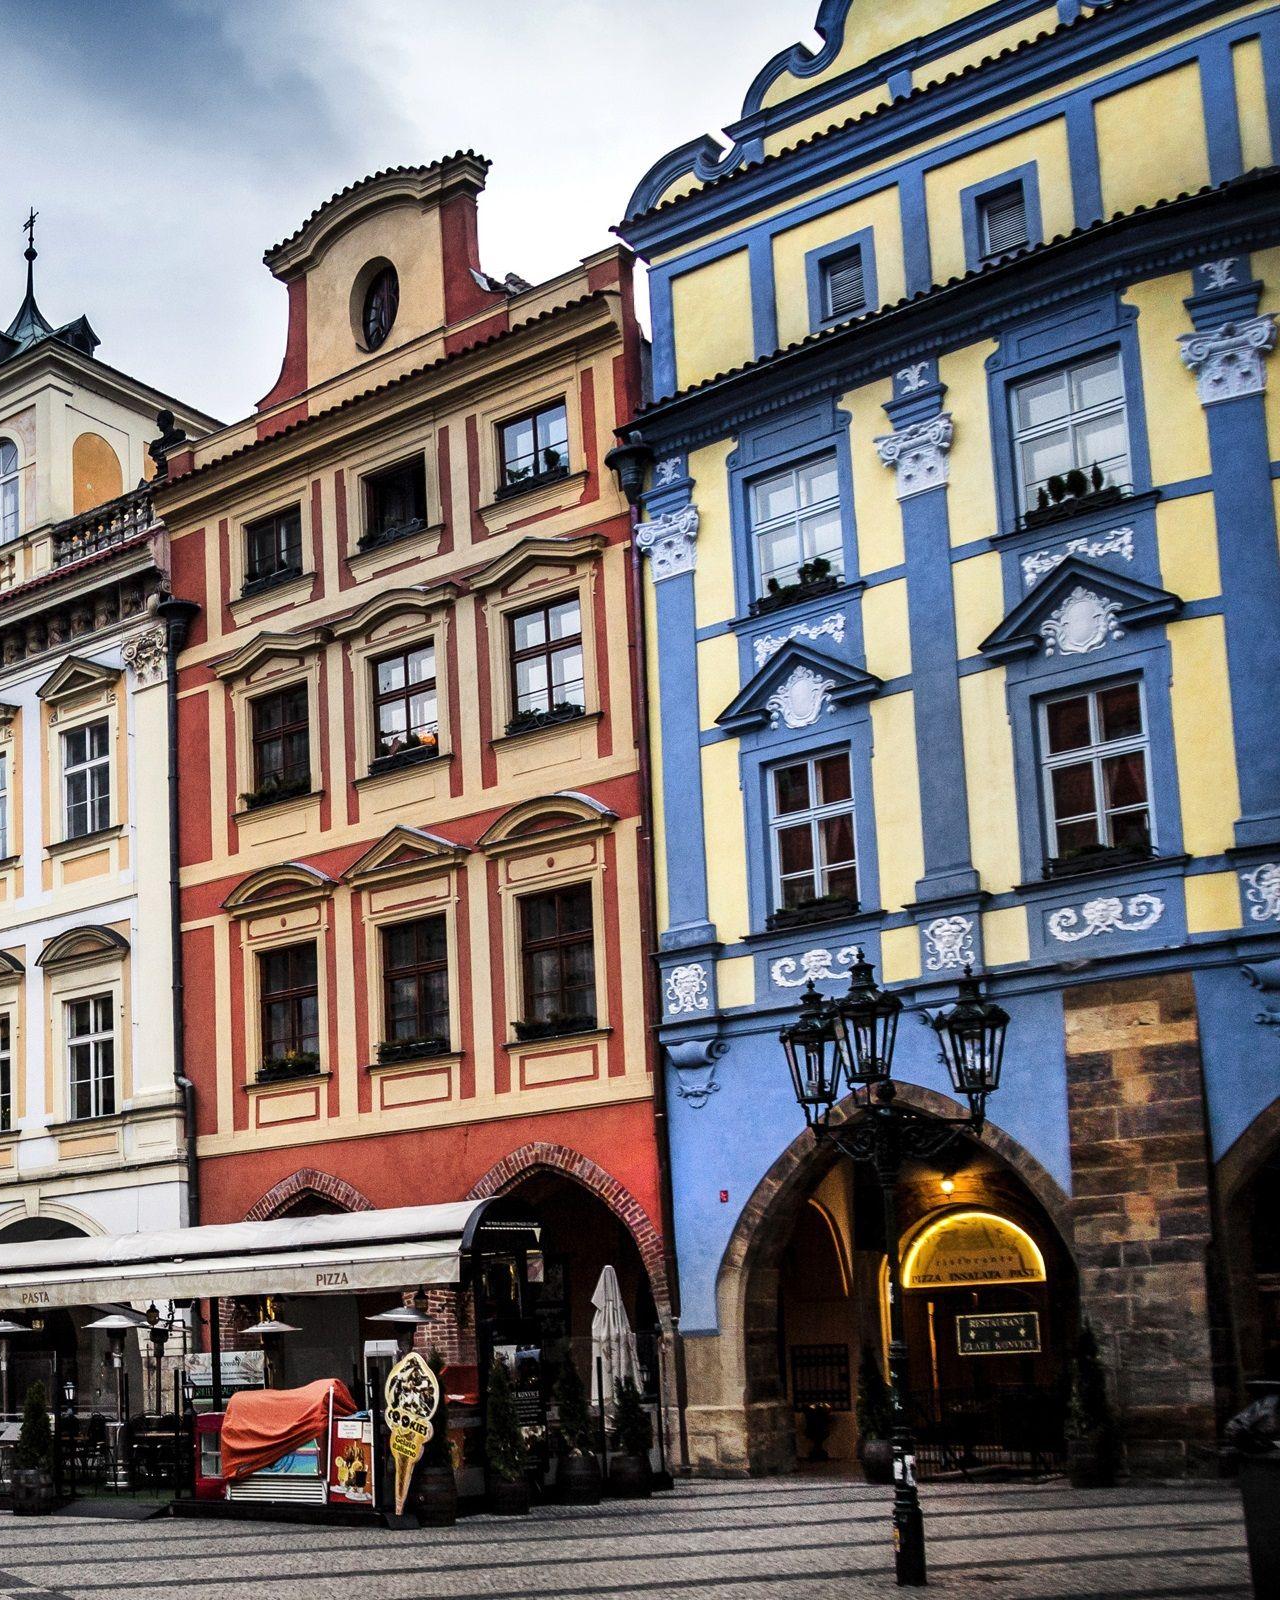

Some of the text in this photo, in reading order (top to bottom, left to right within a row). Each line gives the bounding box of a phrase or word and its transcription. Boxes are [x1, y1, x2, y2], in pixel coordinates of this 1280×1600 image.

[316, 1272, 349, 1286] PIZZA
[912, 1274, 942, 1284] PIZZA
[949, 1271, 1002, 1282] INSALATA
[22, 1291, 50, 1304] PASTA
[388, 1409, 428, 1436] COOKIES
[394, 1434, 417, 1451] Gelato
